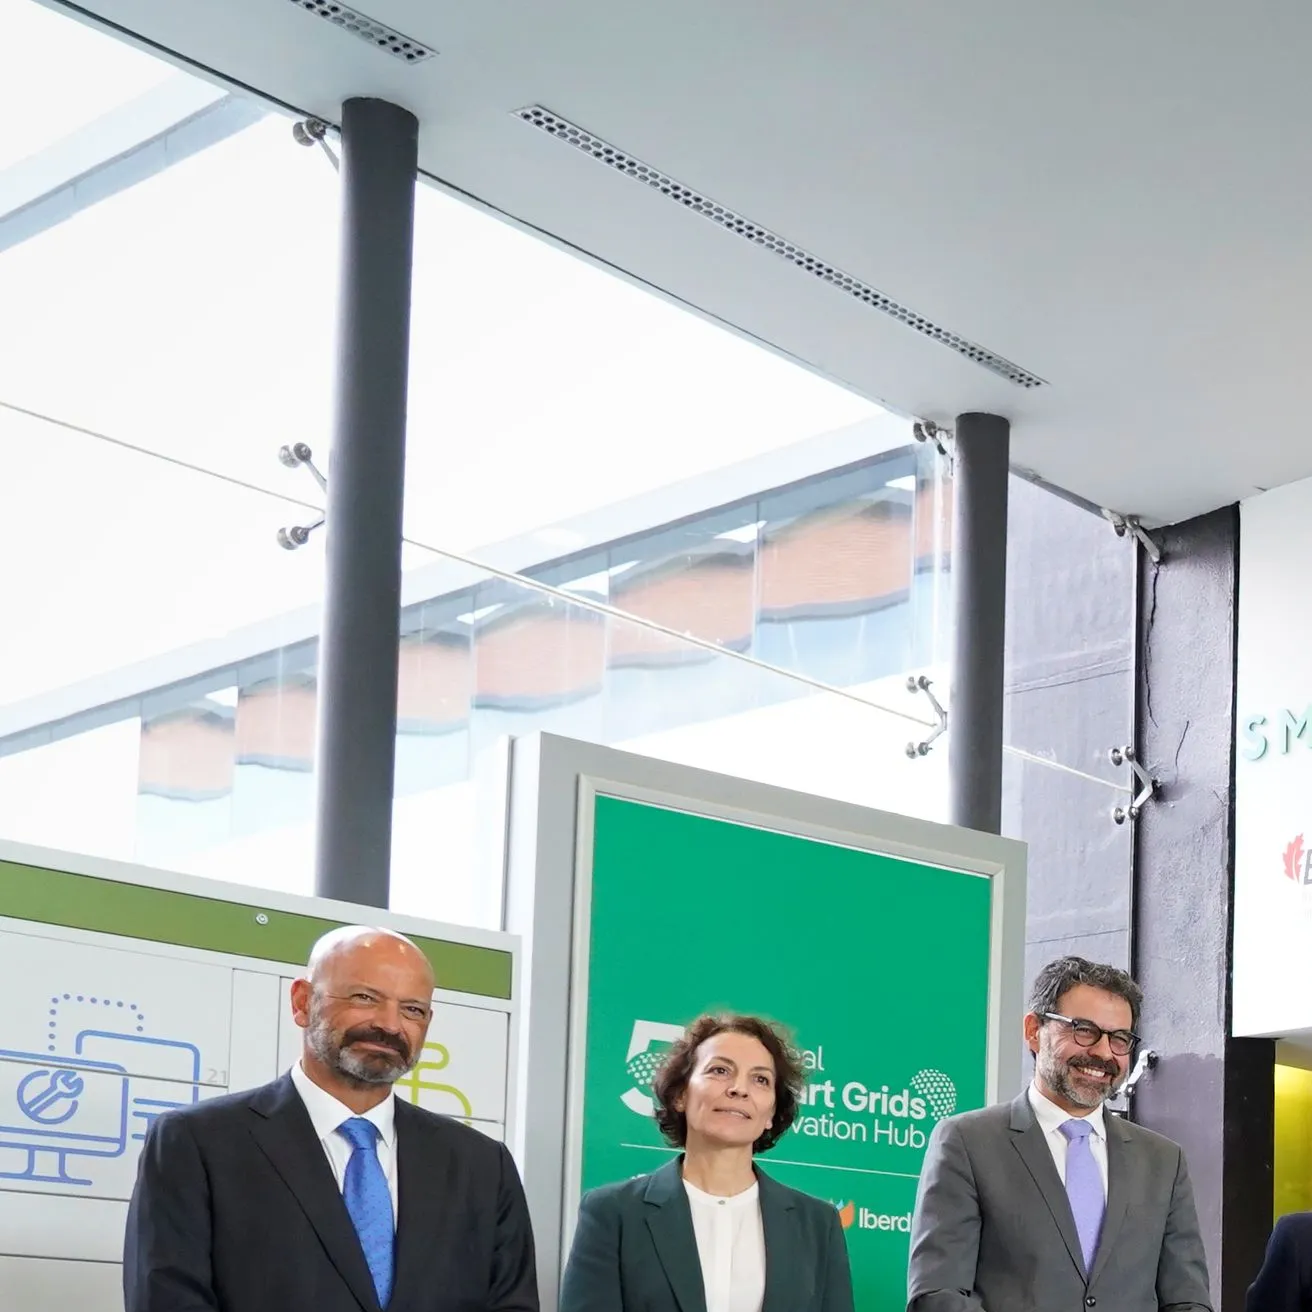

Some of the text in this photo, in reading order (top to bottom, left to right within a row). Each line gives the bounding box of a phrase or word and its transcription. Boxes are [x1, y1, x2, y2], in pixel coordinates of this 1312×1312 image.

[842, 1081, 927, 1120] Grids
[792, 1112, 926, 1149] vation Hub
[858, 1207, 912, 1233] Iberd
